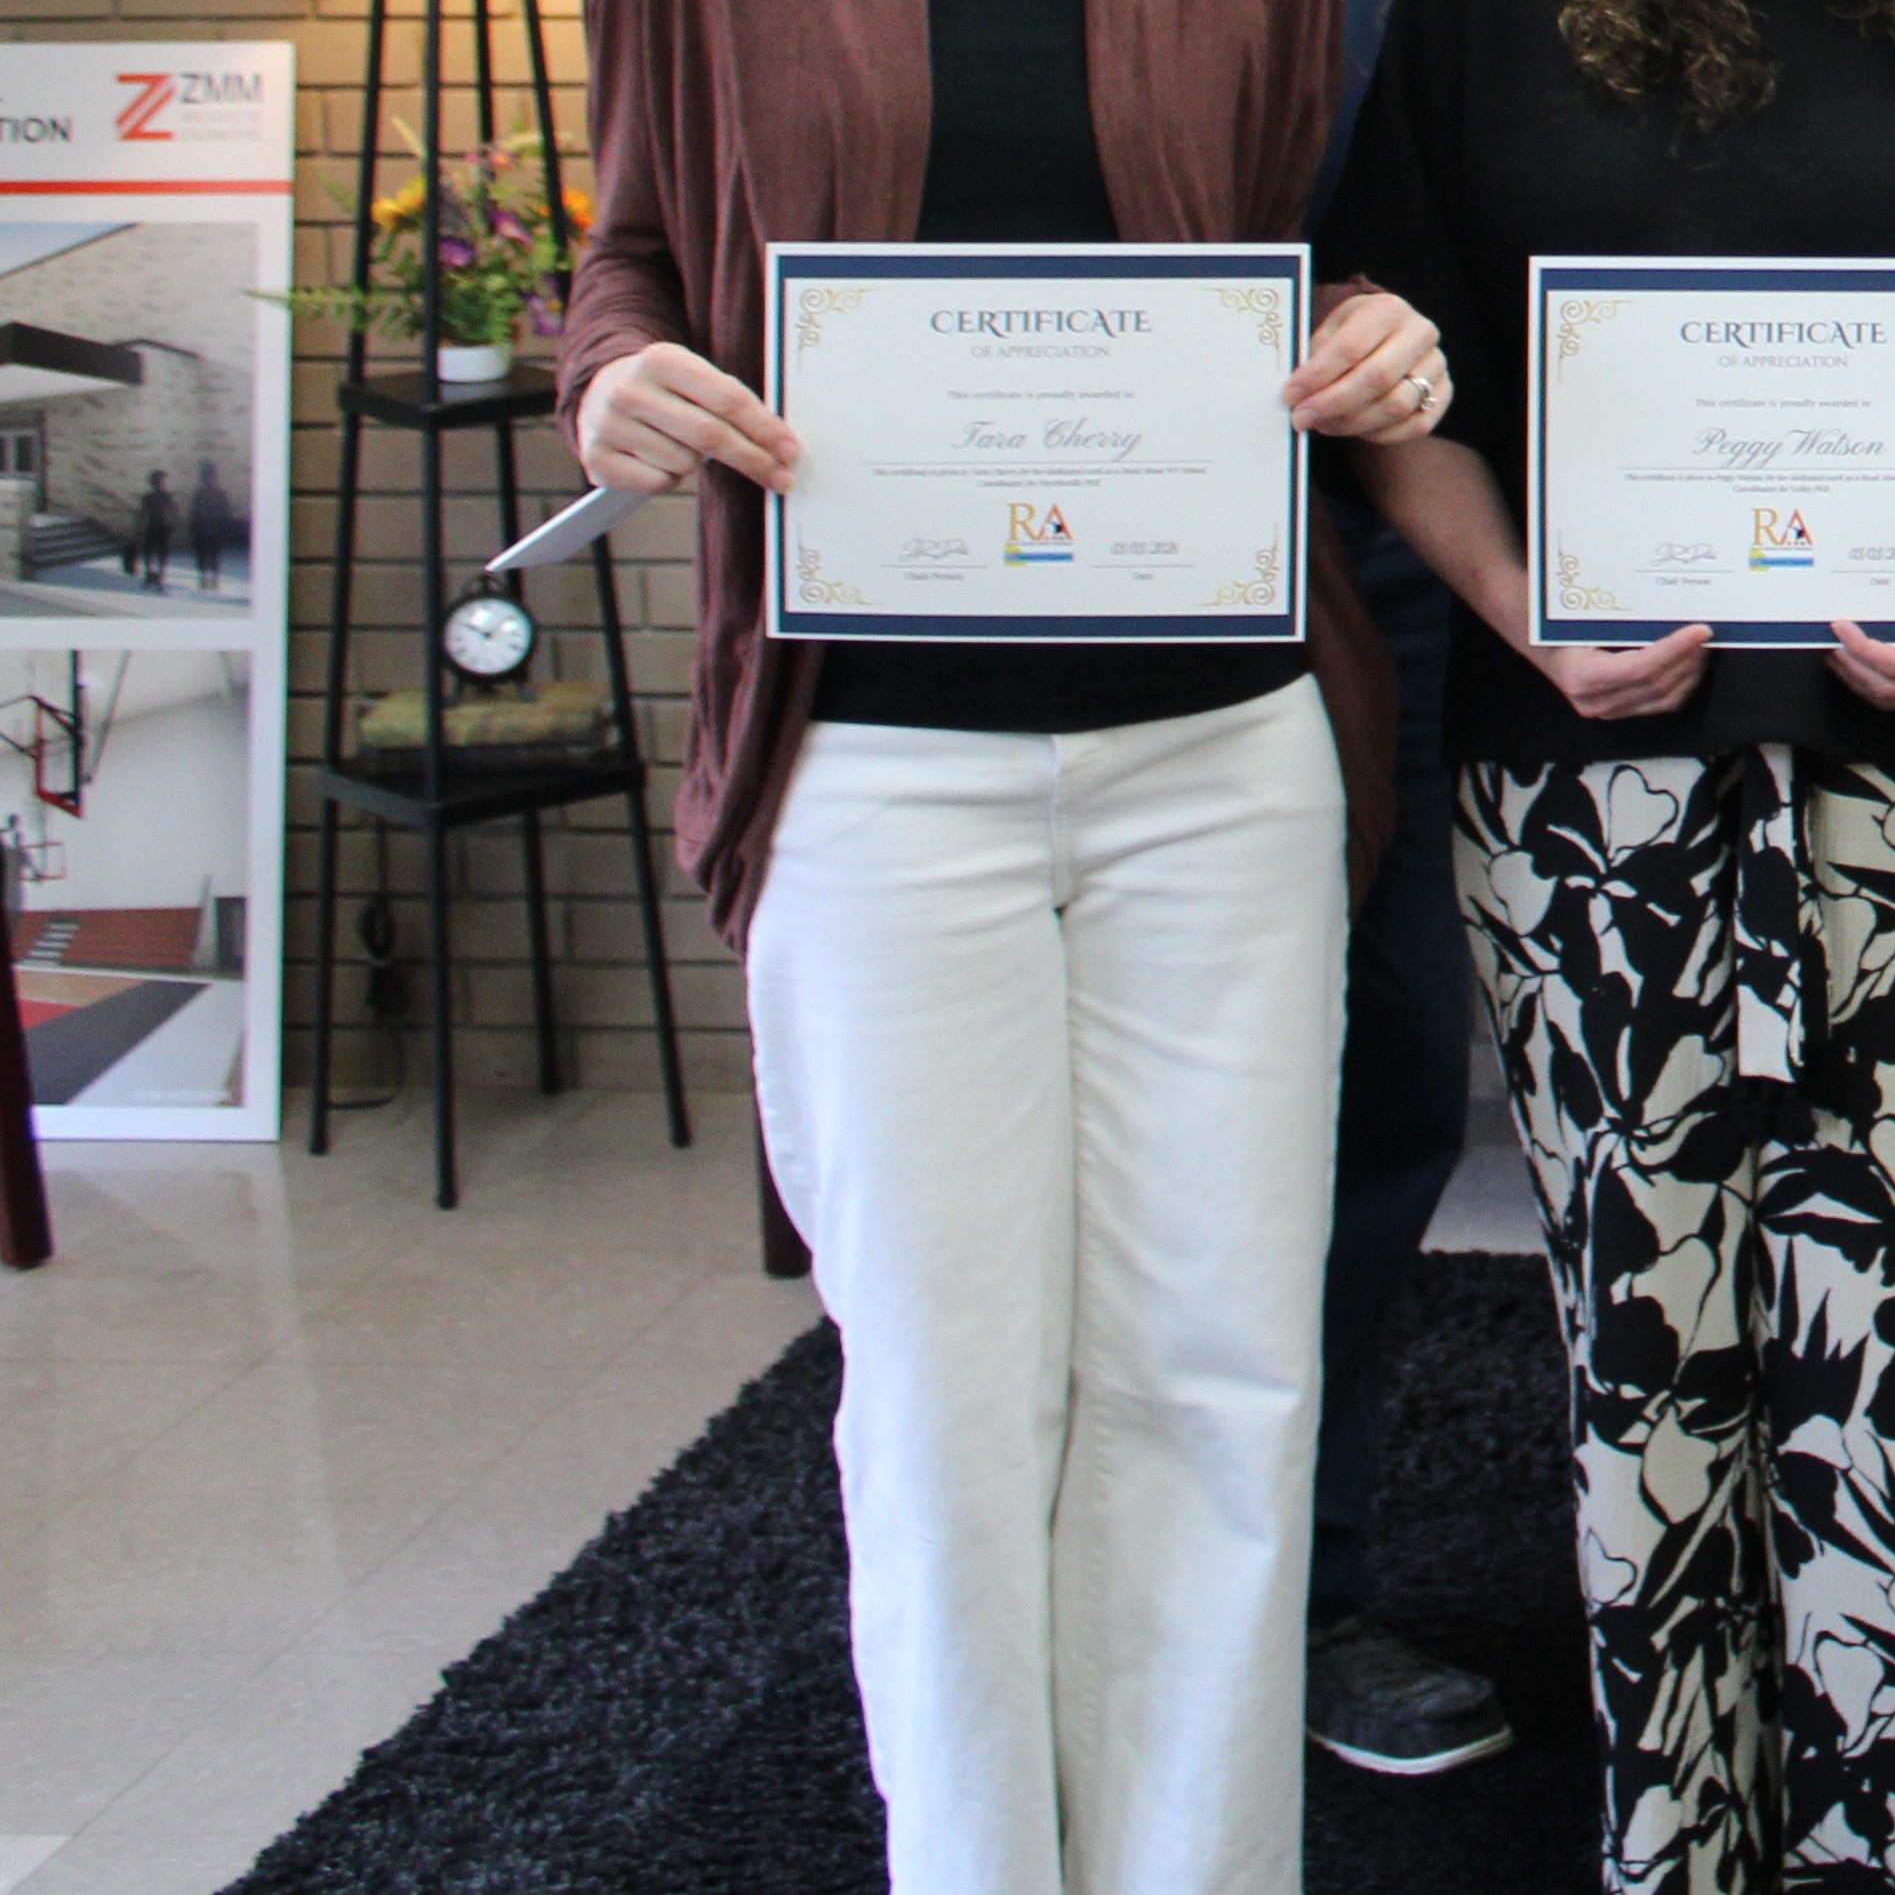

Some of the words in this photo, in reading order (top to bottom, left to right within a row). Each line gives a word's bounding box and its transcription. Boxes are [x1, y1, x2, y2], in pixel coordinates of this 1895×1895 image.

[181, 72, 263, 104] ZMM
[930, 309, 1152, 339] CERTIFICATE
[1680, 320, 1888, 349] CERTIFICATE
[971, 345, 992, 358] OF
[995, 345, 1110, 358] APPRECIATION
[1718, 355, 1738, 368] OF
[1742, 355, 1848, 368] APPRECIATION
[951, 420, 1028, 449] Tara
[1042, 416, 1144, 462] Cherry
[1692, 427, 1783, 469] Peggy
[1785, 428, 1884, 456] Watson
